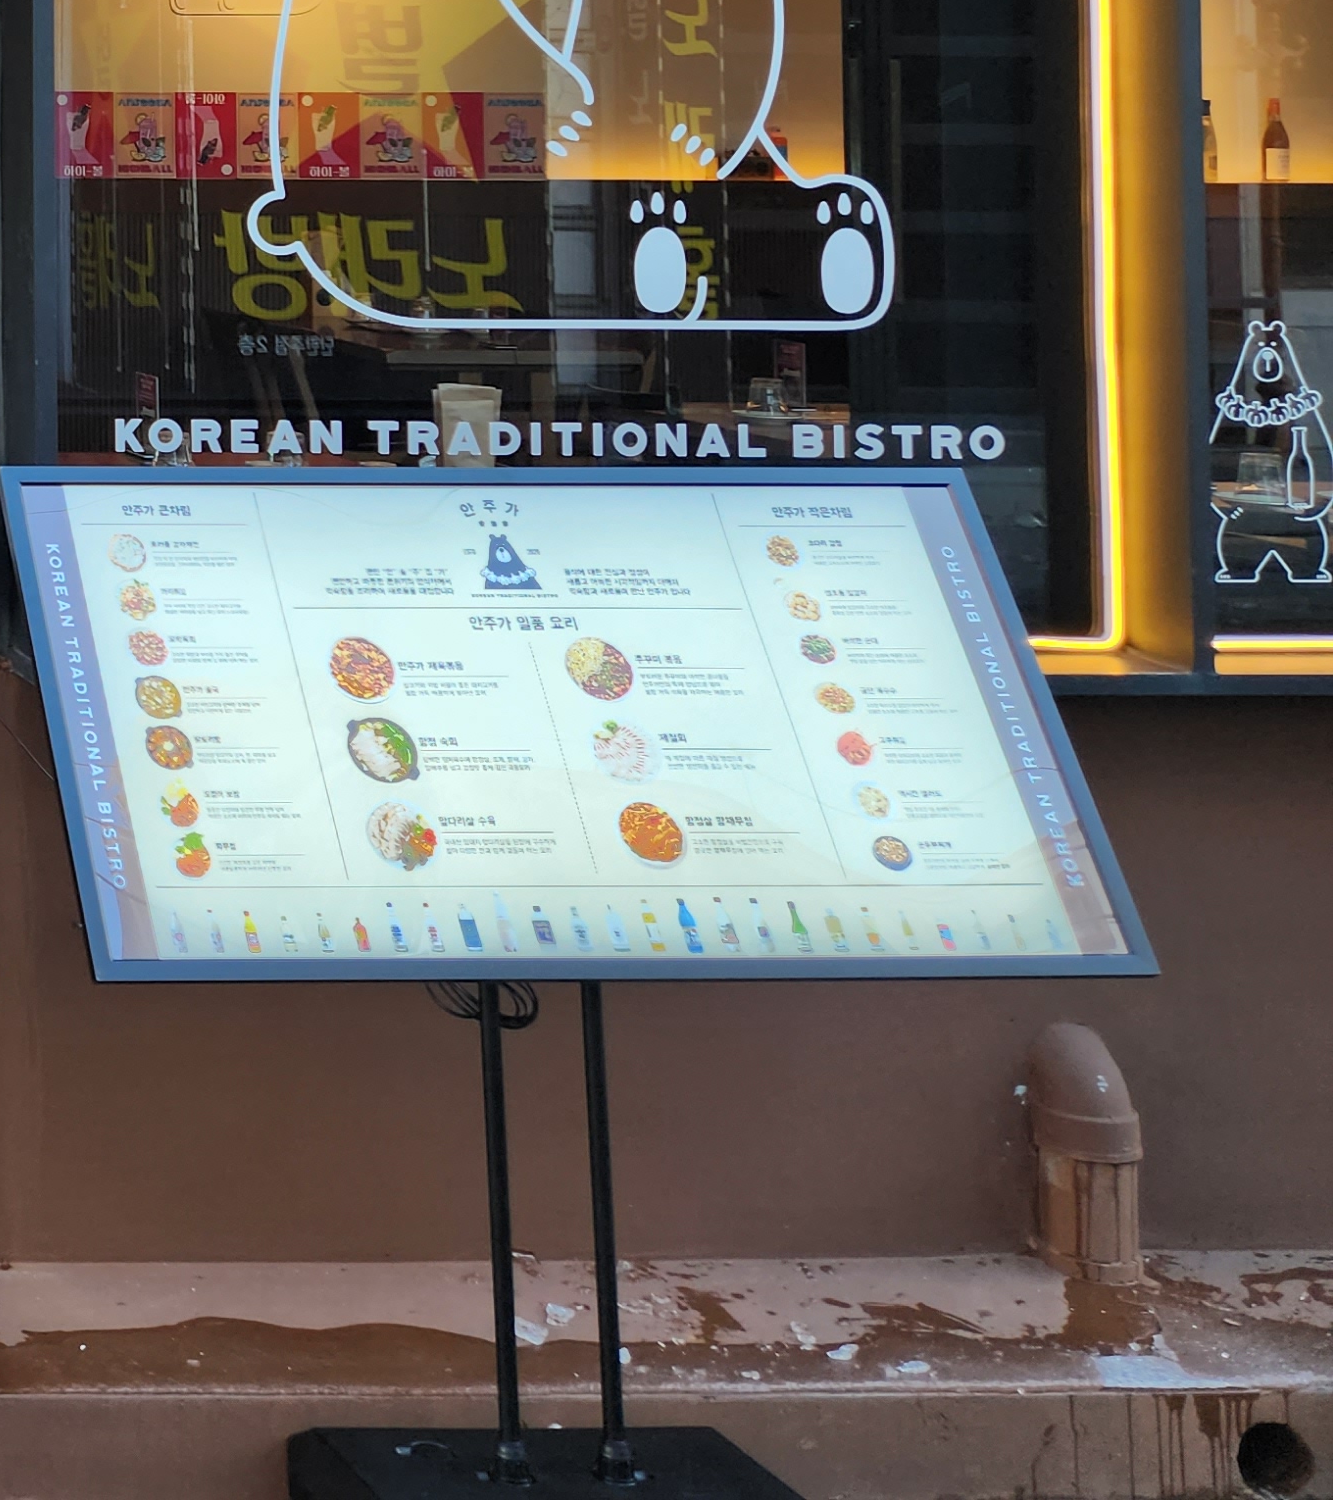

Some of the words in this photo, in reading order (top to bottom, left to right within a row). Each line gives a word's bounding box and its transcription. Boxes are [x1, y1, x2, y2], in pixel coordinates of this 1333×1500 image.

[115, 417, 344, 455] KOREAN
[367, 419, 767, 459] TRADITIONAL
[792, 422, 1006, 460] BISTRO
[122, 505, 154, 516] 안주가
[459, 500, 519, 518] 안주가
[772, 507, 805, 518] 안주가
[941, 545, 980, 624] BISTRO
[469, 616, 511, 631] 안주가
[516, 616, 545, 631] 일품
[550, 616, 579, 631] 요리
[46, 543, 75, 628] KOREAN
[65, 637, 105, 791] TRADITIONAL
[98, 802, 127, 890] BISTRO
[974, 632, 1041, 783] TRADITIONAL
[1035, 794, 1085, 887] KOREAN
